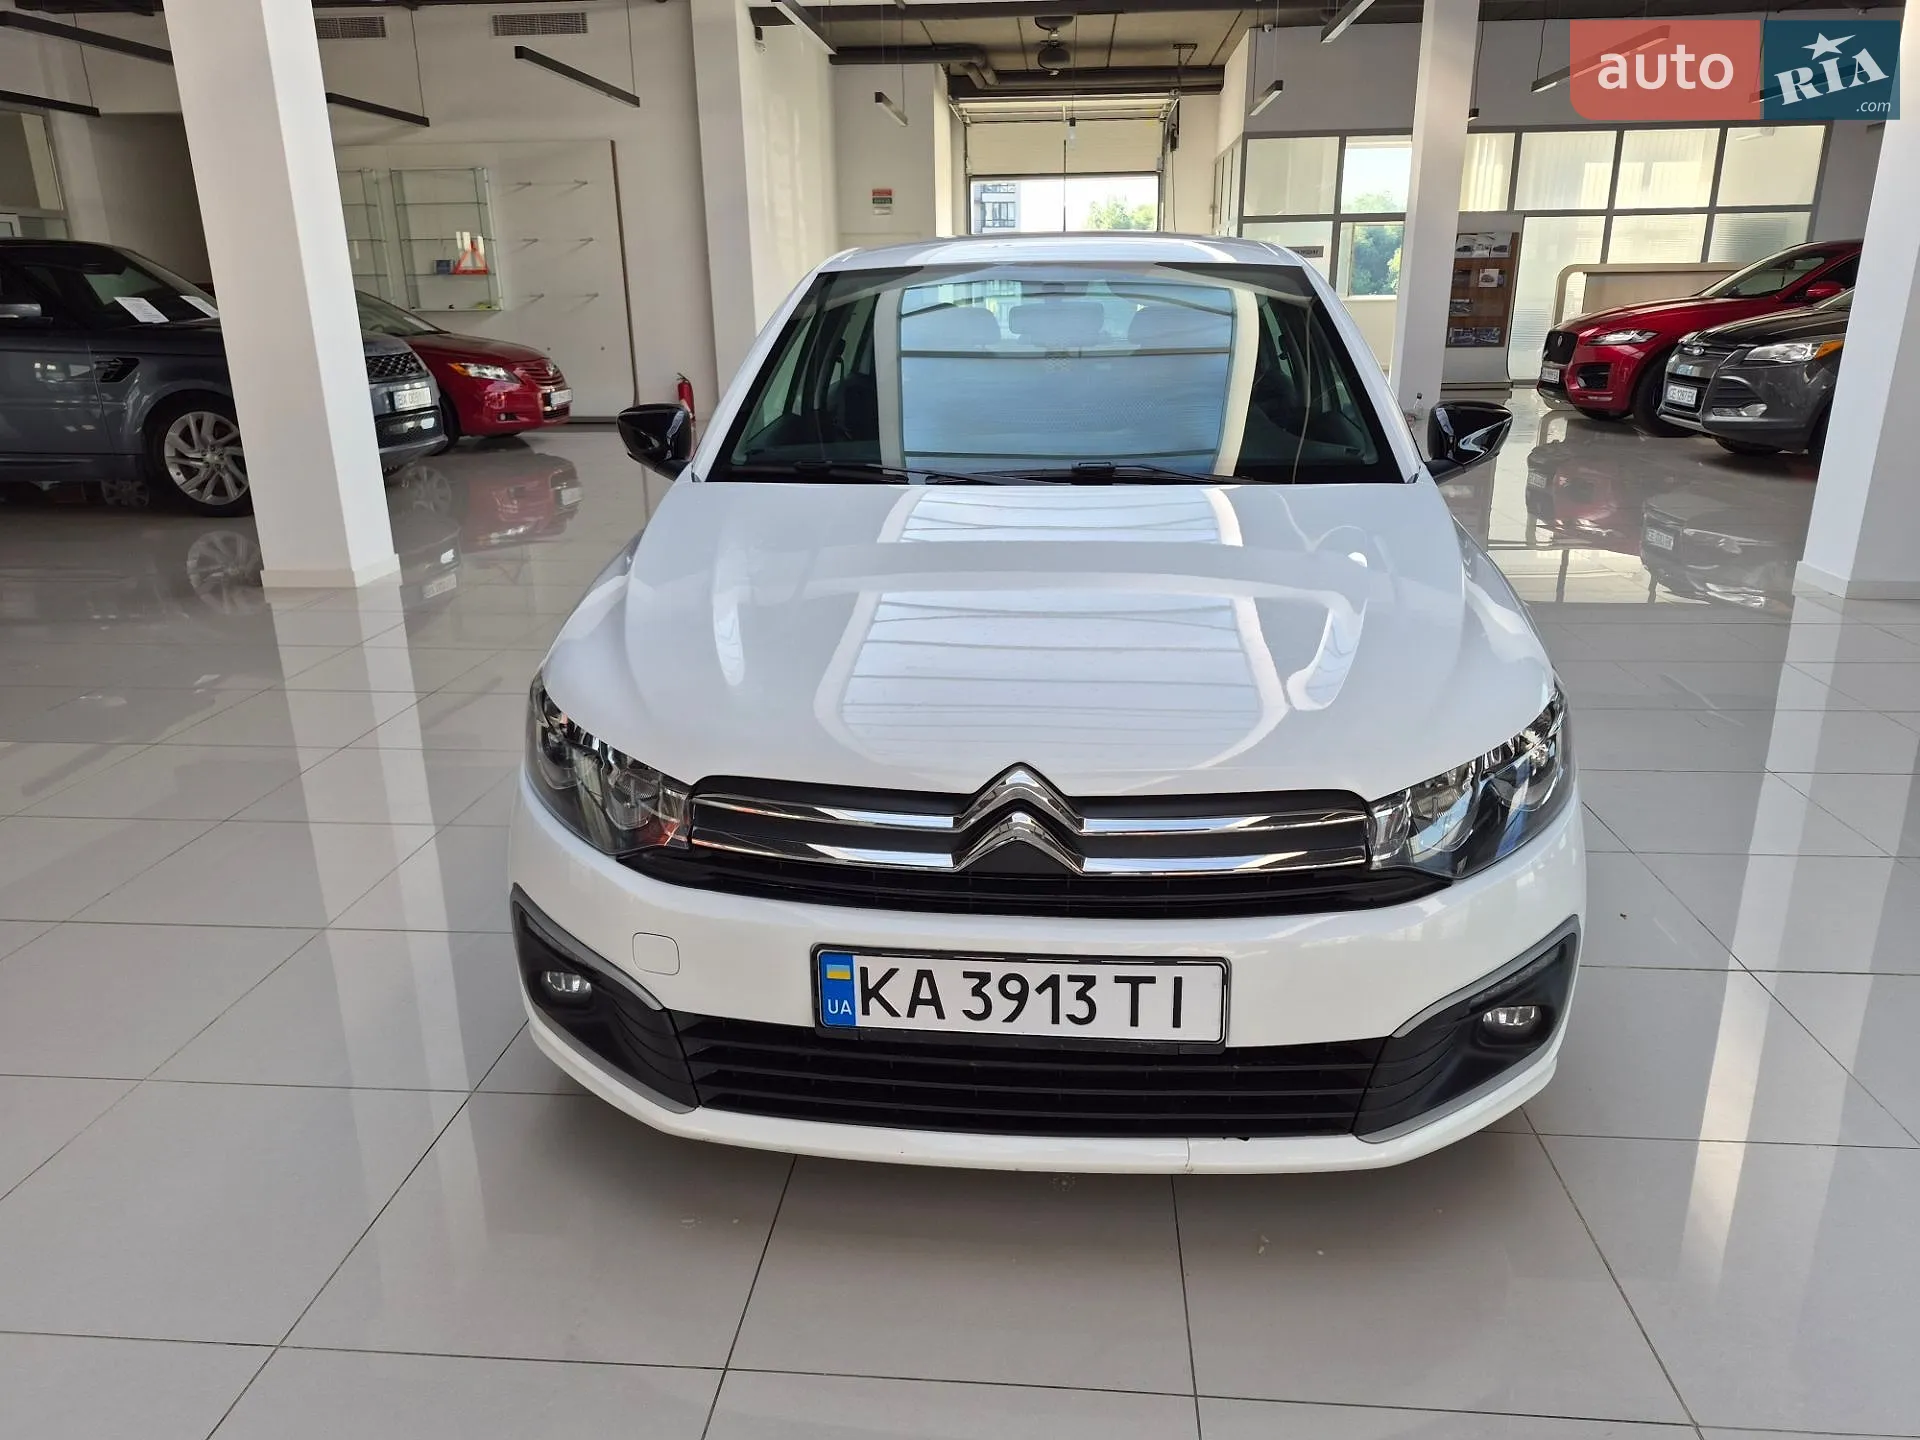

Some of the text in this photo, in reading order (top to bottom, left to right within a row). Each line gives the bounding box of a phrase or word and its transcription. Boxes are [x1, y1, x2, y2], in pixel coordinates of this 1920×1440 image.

[828, 999, 852, 1015] UA
[860, 967, 1183, 1028] KA 3913 TI
